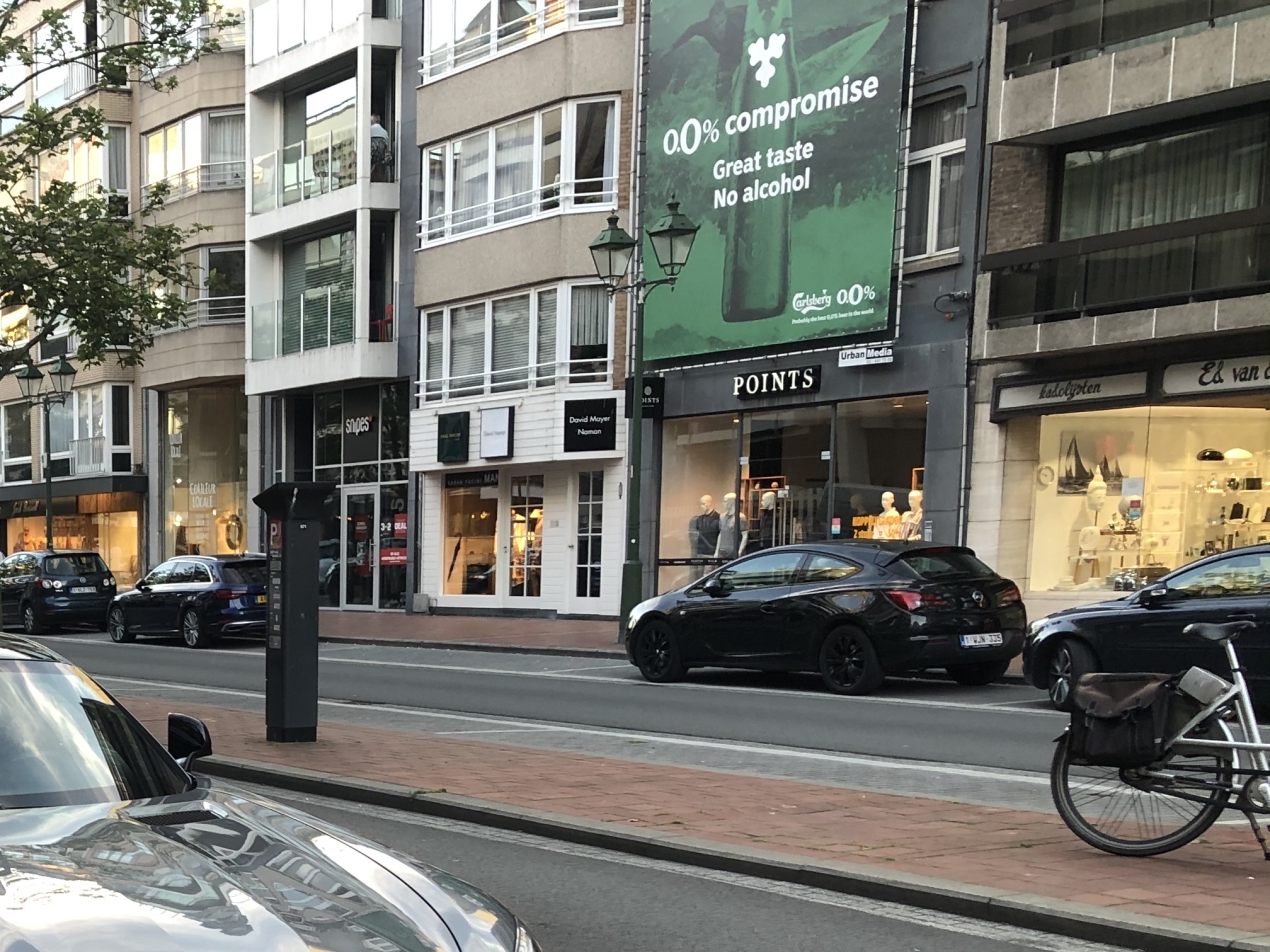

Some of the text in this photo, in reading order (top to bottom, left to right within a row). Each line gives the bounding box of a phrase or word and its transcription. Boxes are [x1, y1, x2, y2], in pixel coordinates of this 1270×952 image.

[725, 75, 879, 135] compromise
[713, 140, 814, 180] Great taste
[714, 167, 810, 209] No alcohol
[792, 290, 831, 314] Carlsberg
[841, 350, 865, 360] Urban
[866, 348, 893, 358] Media
[733, 368, 814, 396] POINTS
[1232, 366, 1260, 383] van
[345, 416, 370, 436] snipes
[569, 416, 610, 424] David Mayer
[189, 482, 216, 495] COULEUR
[192, 496, 213, 508] LOCALE
